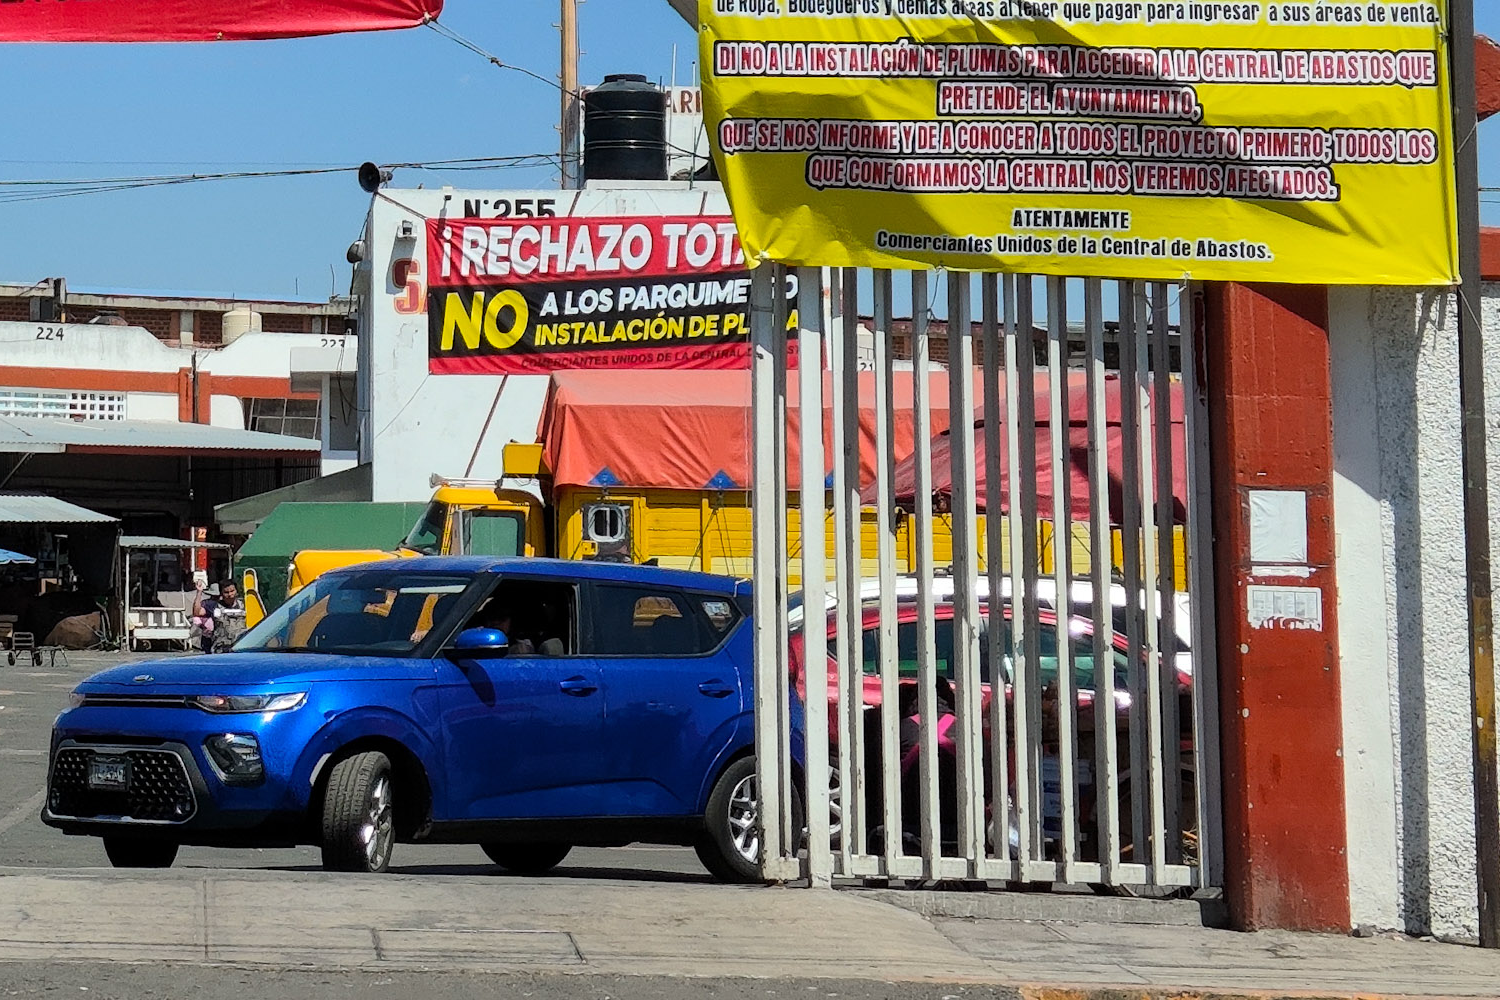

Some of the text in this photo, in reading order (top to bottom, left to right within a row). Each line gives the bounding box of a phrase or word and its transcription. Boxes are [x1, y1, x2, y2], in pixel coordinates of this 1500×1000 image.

[1017, 0, 1058, 18] tener
[1063, 3, 1090, 21] que
[1096, 3, 1142, 22] pagar
[1147, 3, 1183, 22] para
[1188, 3, 1259, 22] ingresar
[1269, 5, 1277, 21] a
[1283, 5, 1312, 21] sus
[1316, 1, 1362, 22] áreas
[1368, 3, 1385, 22] de
[1391, 4, 1439, 22] venta.
[718, 40, 1433, 84] DI NO A LA INSTALACIÓN DE PLUMAS PARA ACCEDER A LA CENTRAL DE ABASTOS QUE
[939, 83, 1199, 119] PRETENDE EL AYUNTAMIENTO,
[722, 122, 1434, 162] QUE SE NOS INFORME Y DE A CONOCER A TODOS EL PROYECTO PRIMERO; TODOS LOS
[810, 157, 1337, 197] QUE CONFORMAMOS LA CENTRAL NOS VEREMOS AFECTADOS.
[1013, 210, 1129, 229] ATENTAMENTE
[877, 231, 1271, 258] Comerciantes Unidos de la Central de Abastos.
[540, 292, 558, 316] A
[565, 288, 613, 314] LOS
[36, 327, 64, 341] 224
[441, 290, 529, 351] NO
[535, 311, 720, 346] INSTALACIÓN DE
[522, 356, 608, 367] COMERCIANTES
[612, 354, 653, 364] UNIDOS
[657, 353, 671, 362] DE
[675, 351, 687, 361] LA
